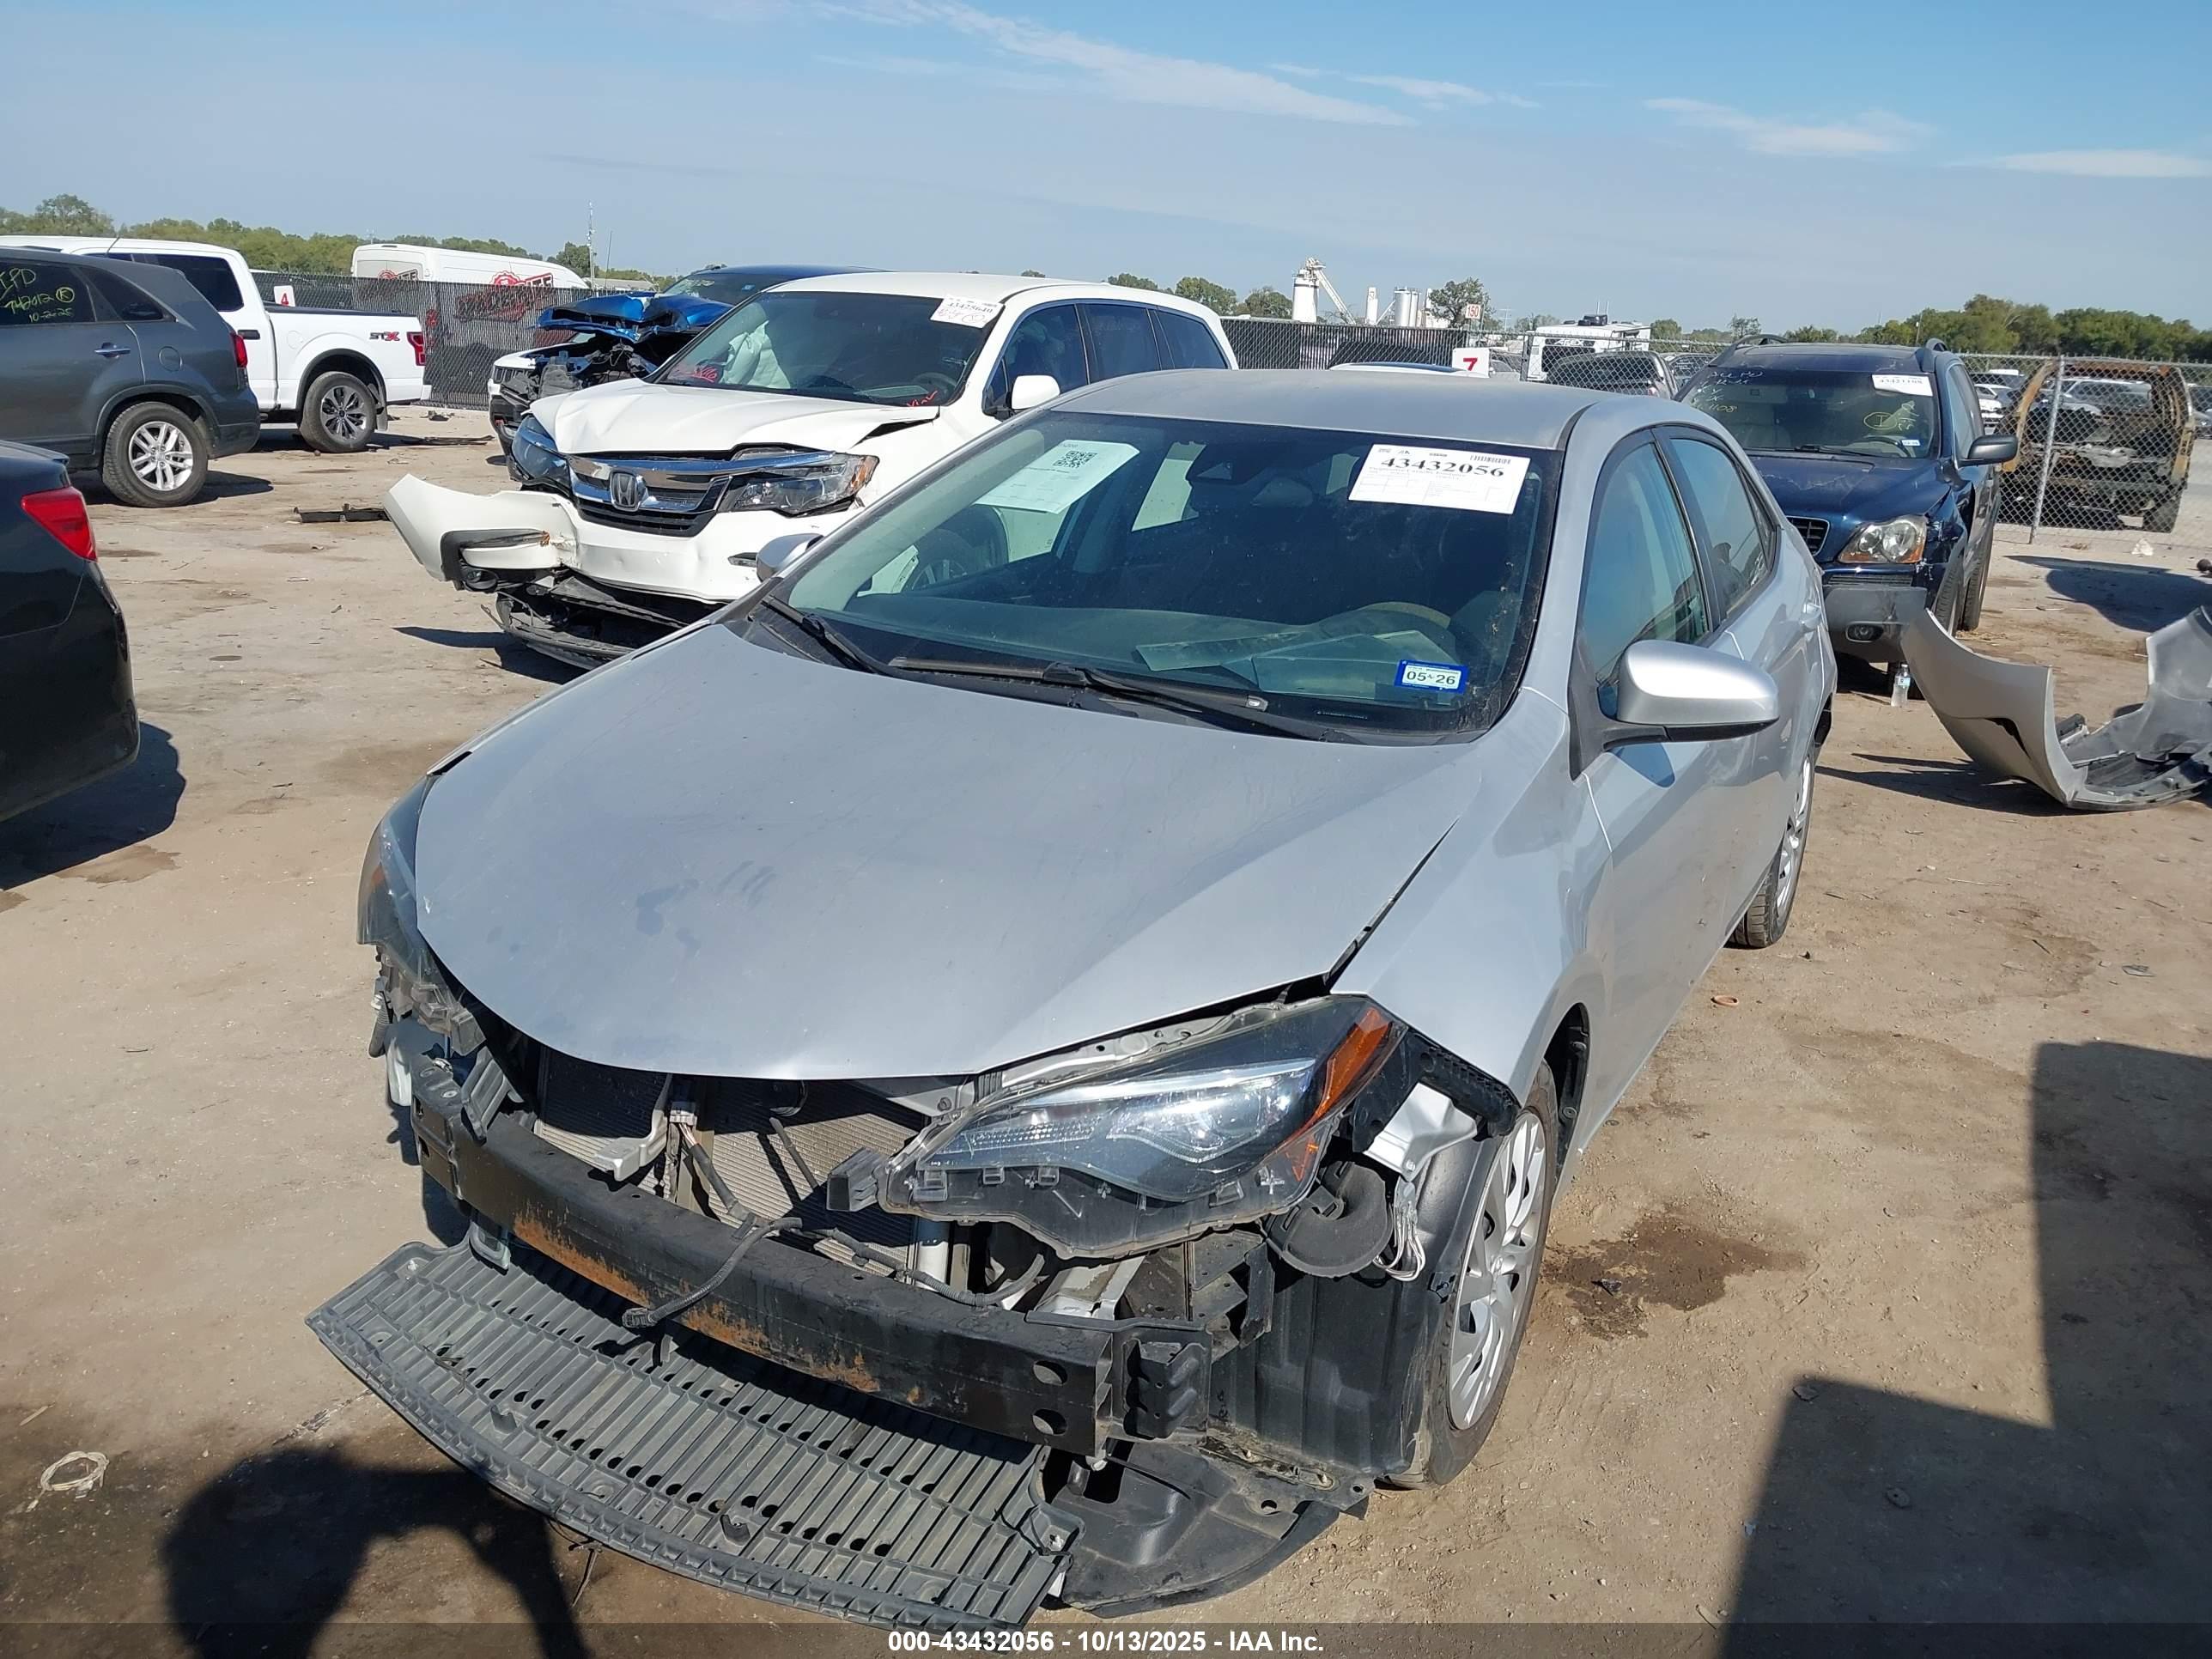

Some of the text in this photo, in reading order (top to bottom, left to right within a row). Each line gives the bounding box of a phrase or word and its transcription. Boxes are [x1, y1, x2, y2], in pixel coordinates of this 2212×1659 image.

[280, 293, 289, 306] 4
[1468, 306, 1480, 318] 150
[369, 331, 400, 341] STX
[1462, 357, 1478, 371] 7
[1381, 457, 1504, 477] 43432056
[1407, 671, 1455, 685] 05 26
